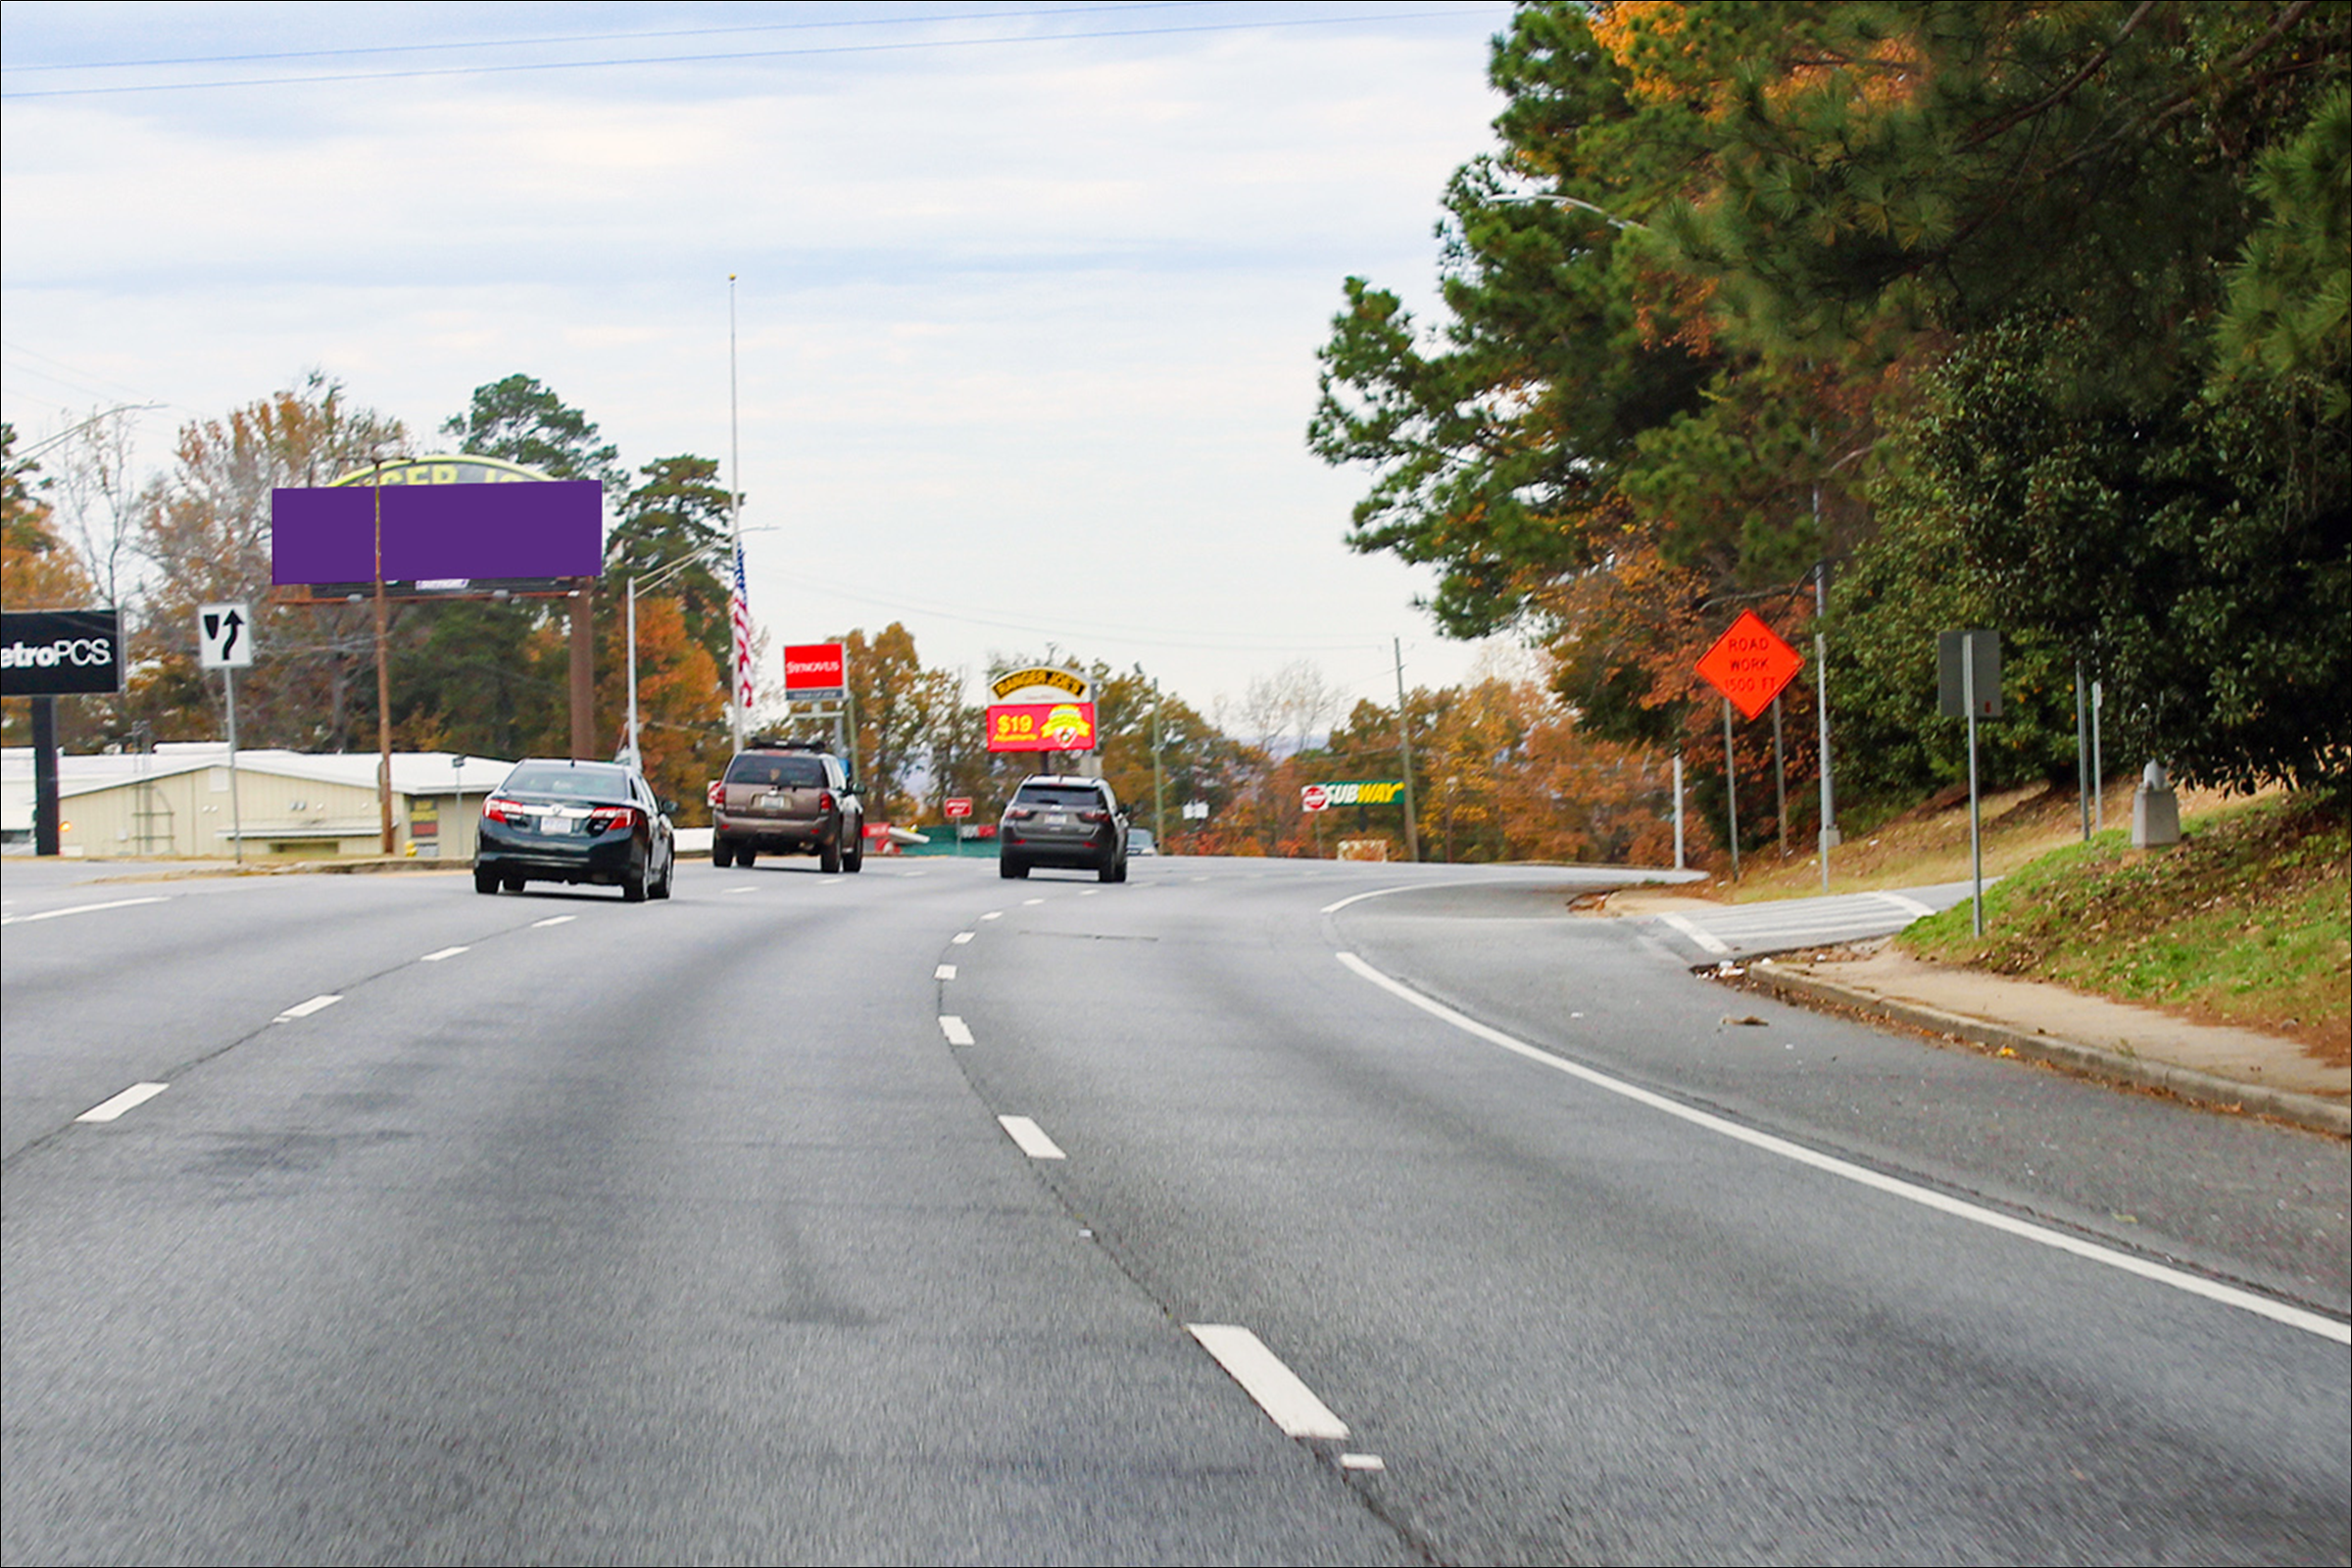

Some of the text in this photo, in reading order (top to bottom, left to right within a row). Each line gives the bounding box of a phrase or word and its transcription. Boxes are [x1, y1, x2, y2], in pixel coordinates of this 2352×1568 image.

[1729, 638, 1769, 653] ROAD
[1730, 656, 1769, 671] WORK
[1726, 676, 1777, 692] 1500 FT
[997, 713, 1034, 734] $19
[1325, 781, 1405, 805] SUBWAY
